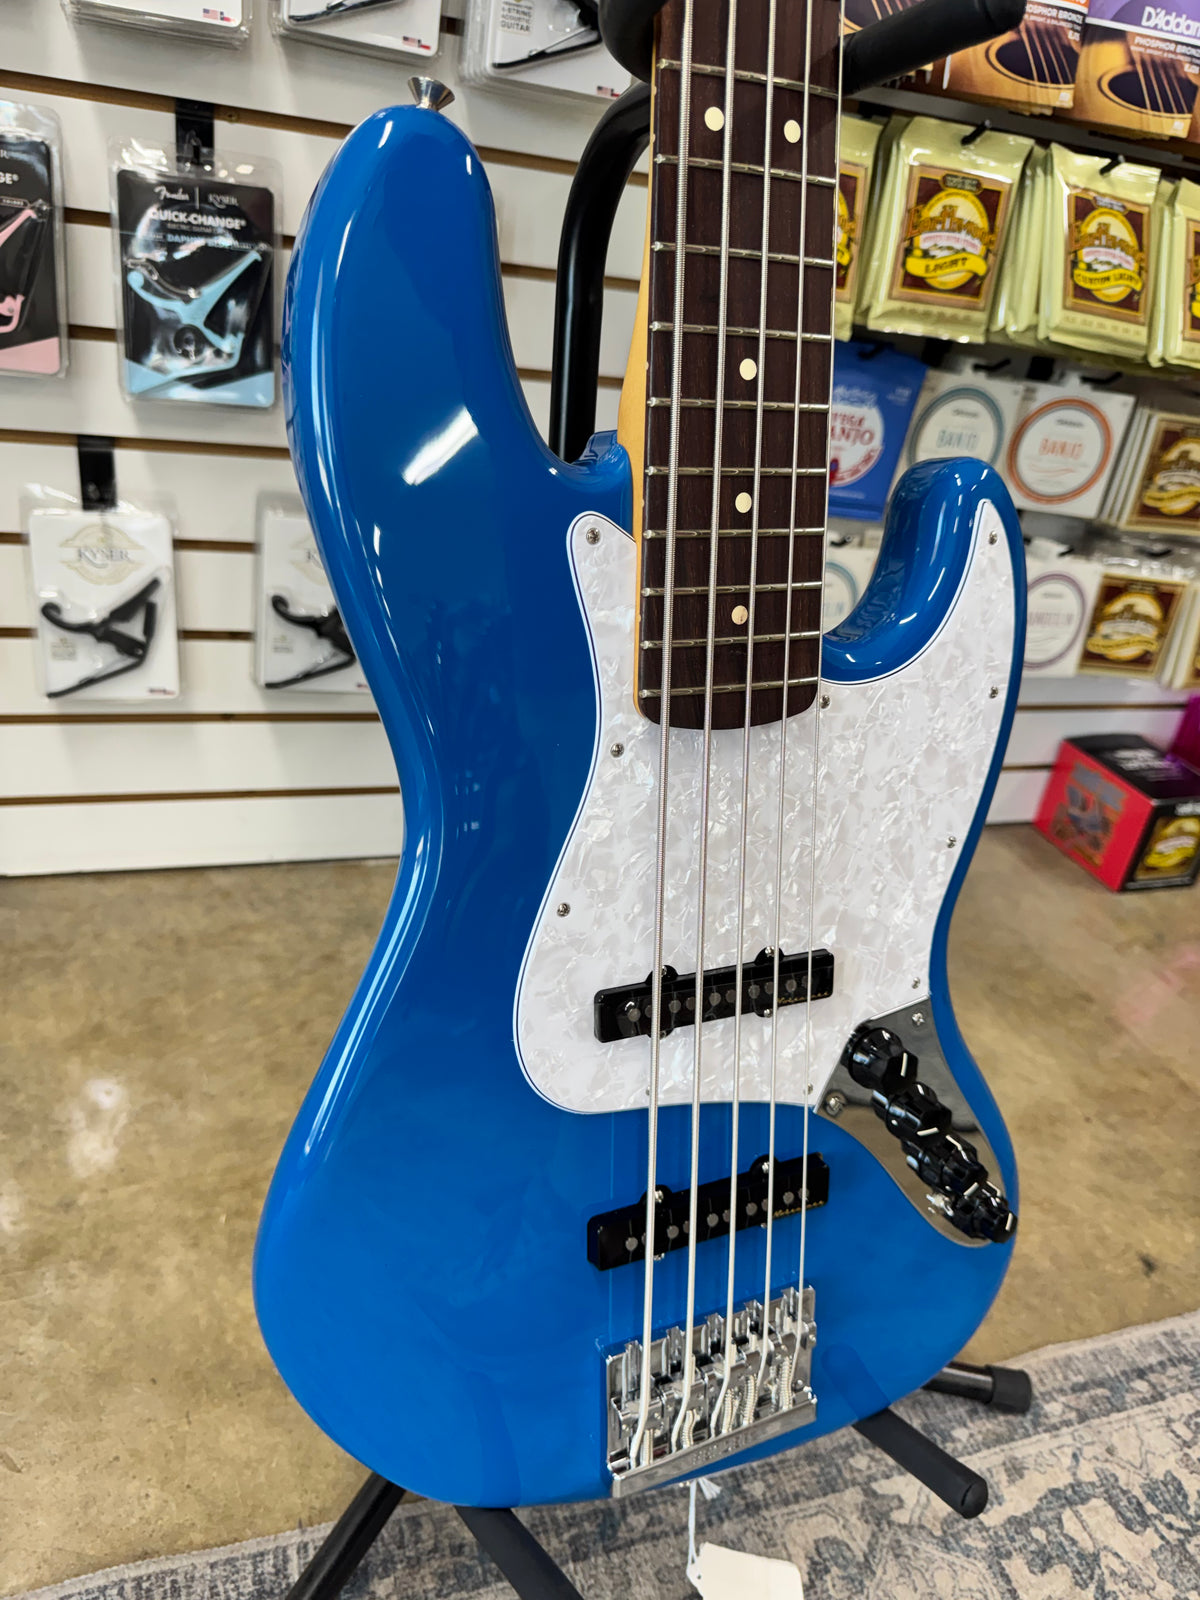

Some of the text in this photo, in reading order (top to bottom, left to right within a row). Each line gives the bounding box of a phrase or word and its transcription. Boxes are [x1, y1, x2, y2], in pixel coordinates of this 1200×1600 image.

[1025, 3, 1058, 18] OSPHOR
[1141, 6, 1200, 38] D'Addar
[500, 20, 530, 33] GUITAR
[1134, 36, 1176, 52] PHOSPHOR
[1175, 44, 1200, 59] BRONZ
[154, 186, 189, 200] Fender
[924, 256, 969, 274] LIGHT
[830, 424, 875, 447] ANJO
[1039, 436, 1085, 460] BANJO
[78, 546, 135, 569] KYSER
